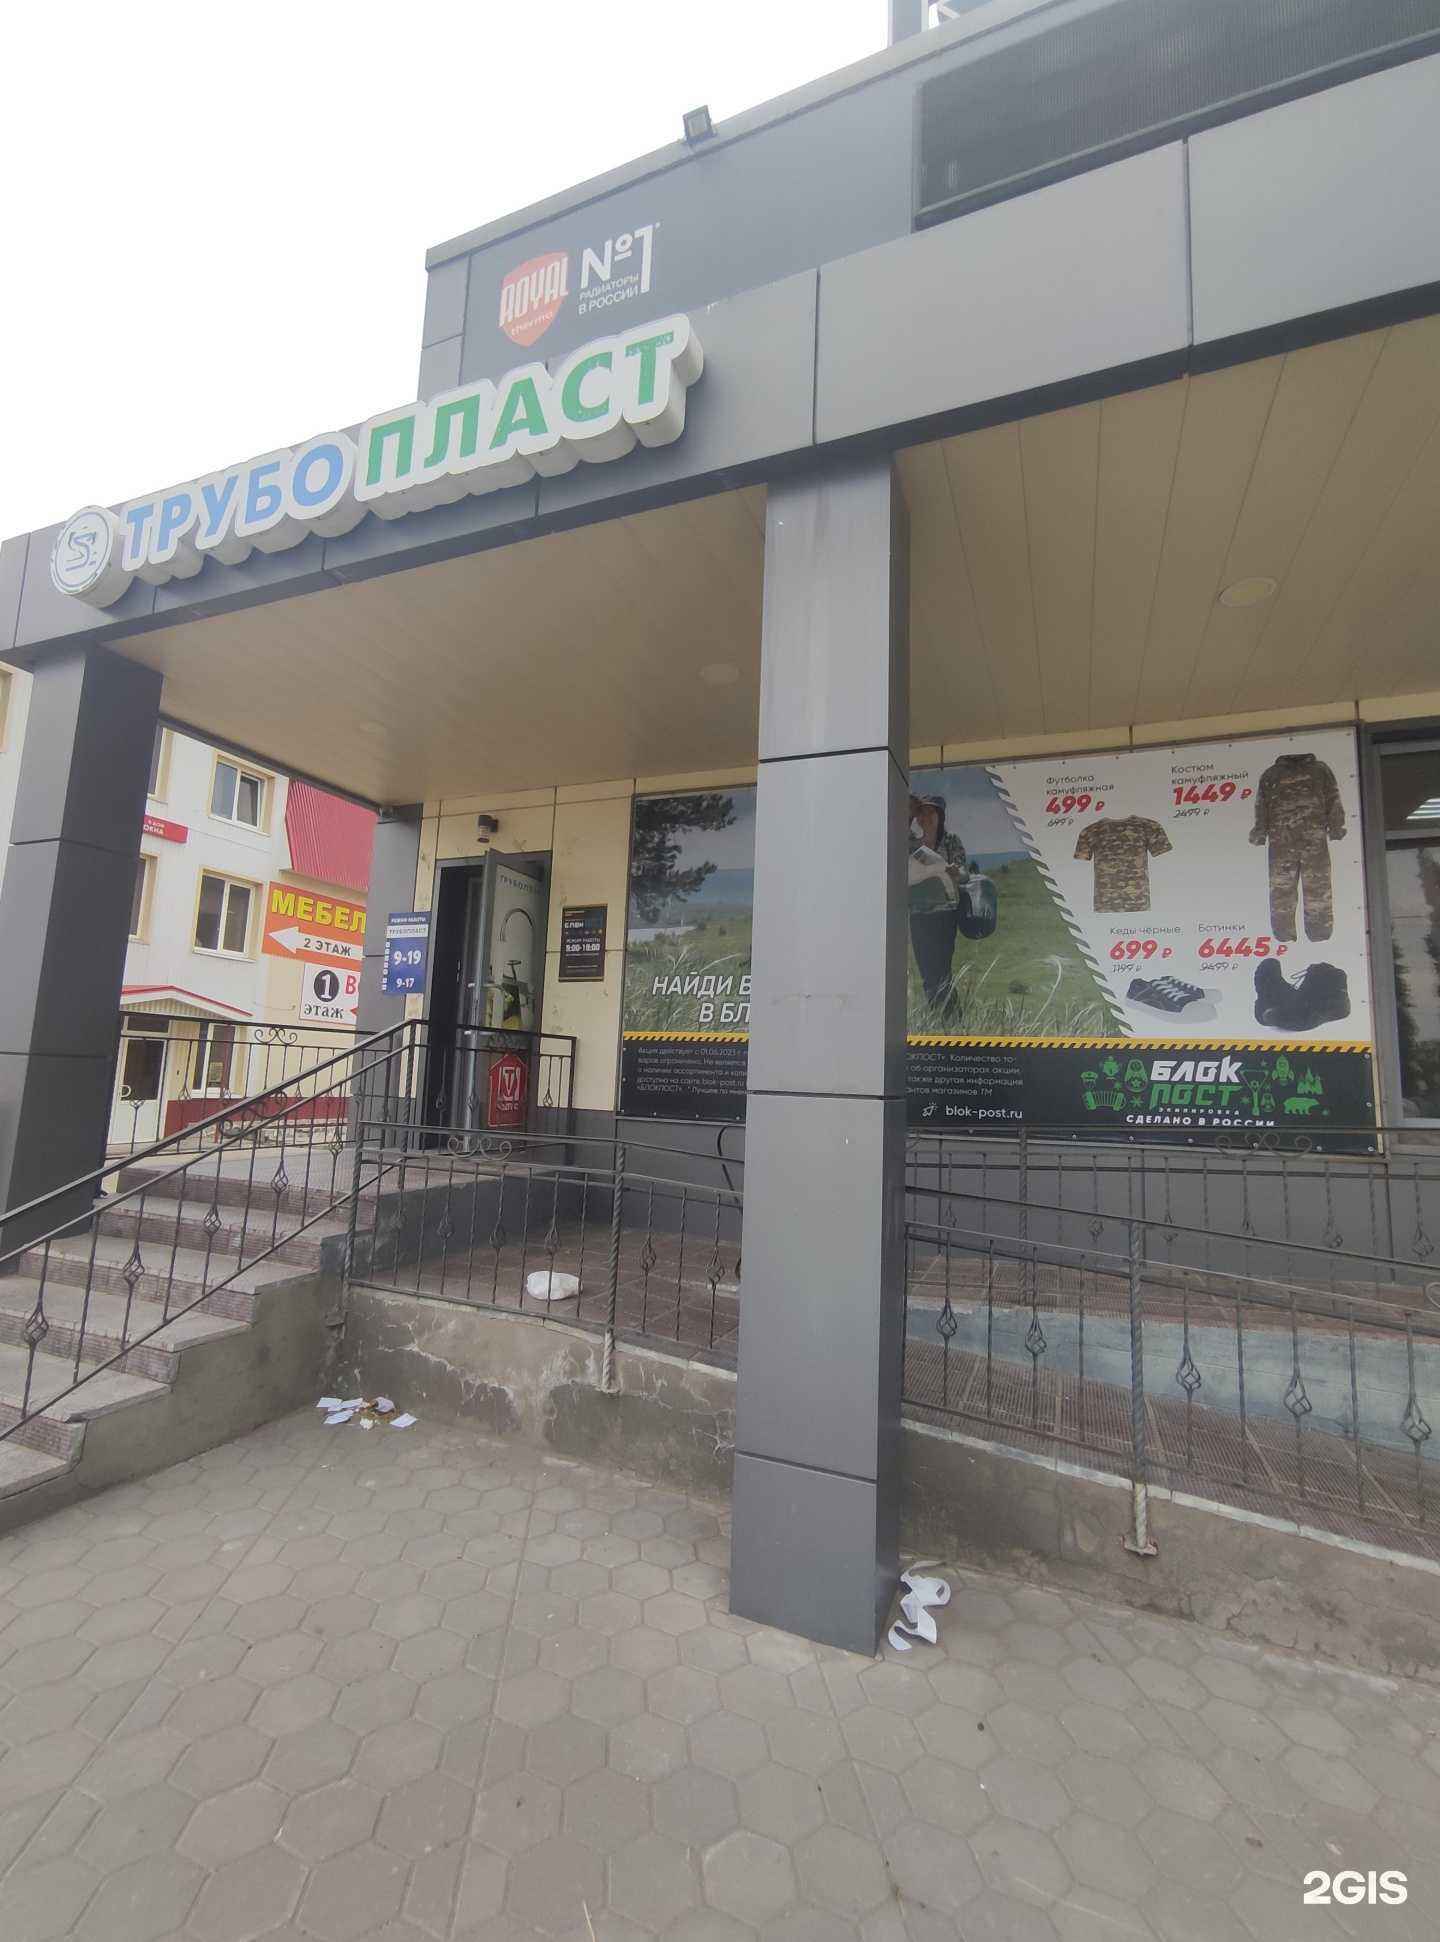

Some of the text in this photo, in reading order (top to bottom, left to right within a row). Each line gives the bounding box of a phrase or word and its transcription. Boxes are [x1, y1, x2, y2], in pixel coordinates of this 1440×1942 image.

[578, 285, 640, 315] В РОССИИ
[1171, 764, 1215, 774] Костюм
[1046, 776, 1095, 784] Футболка
[1173, 782, 1237, 805] 1449
[1046, 795, 1092, 814] 499
[271, 889, 366, 934] МЕБЕЛ
[1110, 927, 1137, 936] Кеды
[1198, 923, 1246, 932] Ботинки
[304, 938, 351, 957] 2 ЭТАЖ
[1110, 939, 1158, 960] 699
[1198, 937, 1271, 958] 6445
[321, 974, 332, 1000] 1
[652, 971, 734, 998] НАЙДИ
[304, 1003, 344, 1019] этаж
[699, 1002, 714, 1022] В
[1150, 1055, 1243, 1083] БЛОК
[1150, 1084, 1243, 1109] ПОСТ
[945, 1105, 1023, 1120] blok-post.ru
[1126, 1115, 1192, 1125] СДЕЛАНО
[1198, 1118, 1206, 1126] В
